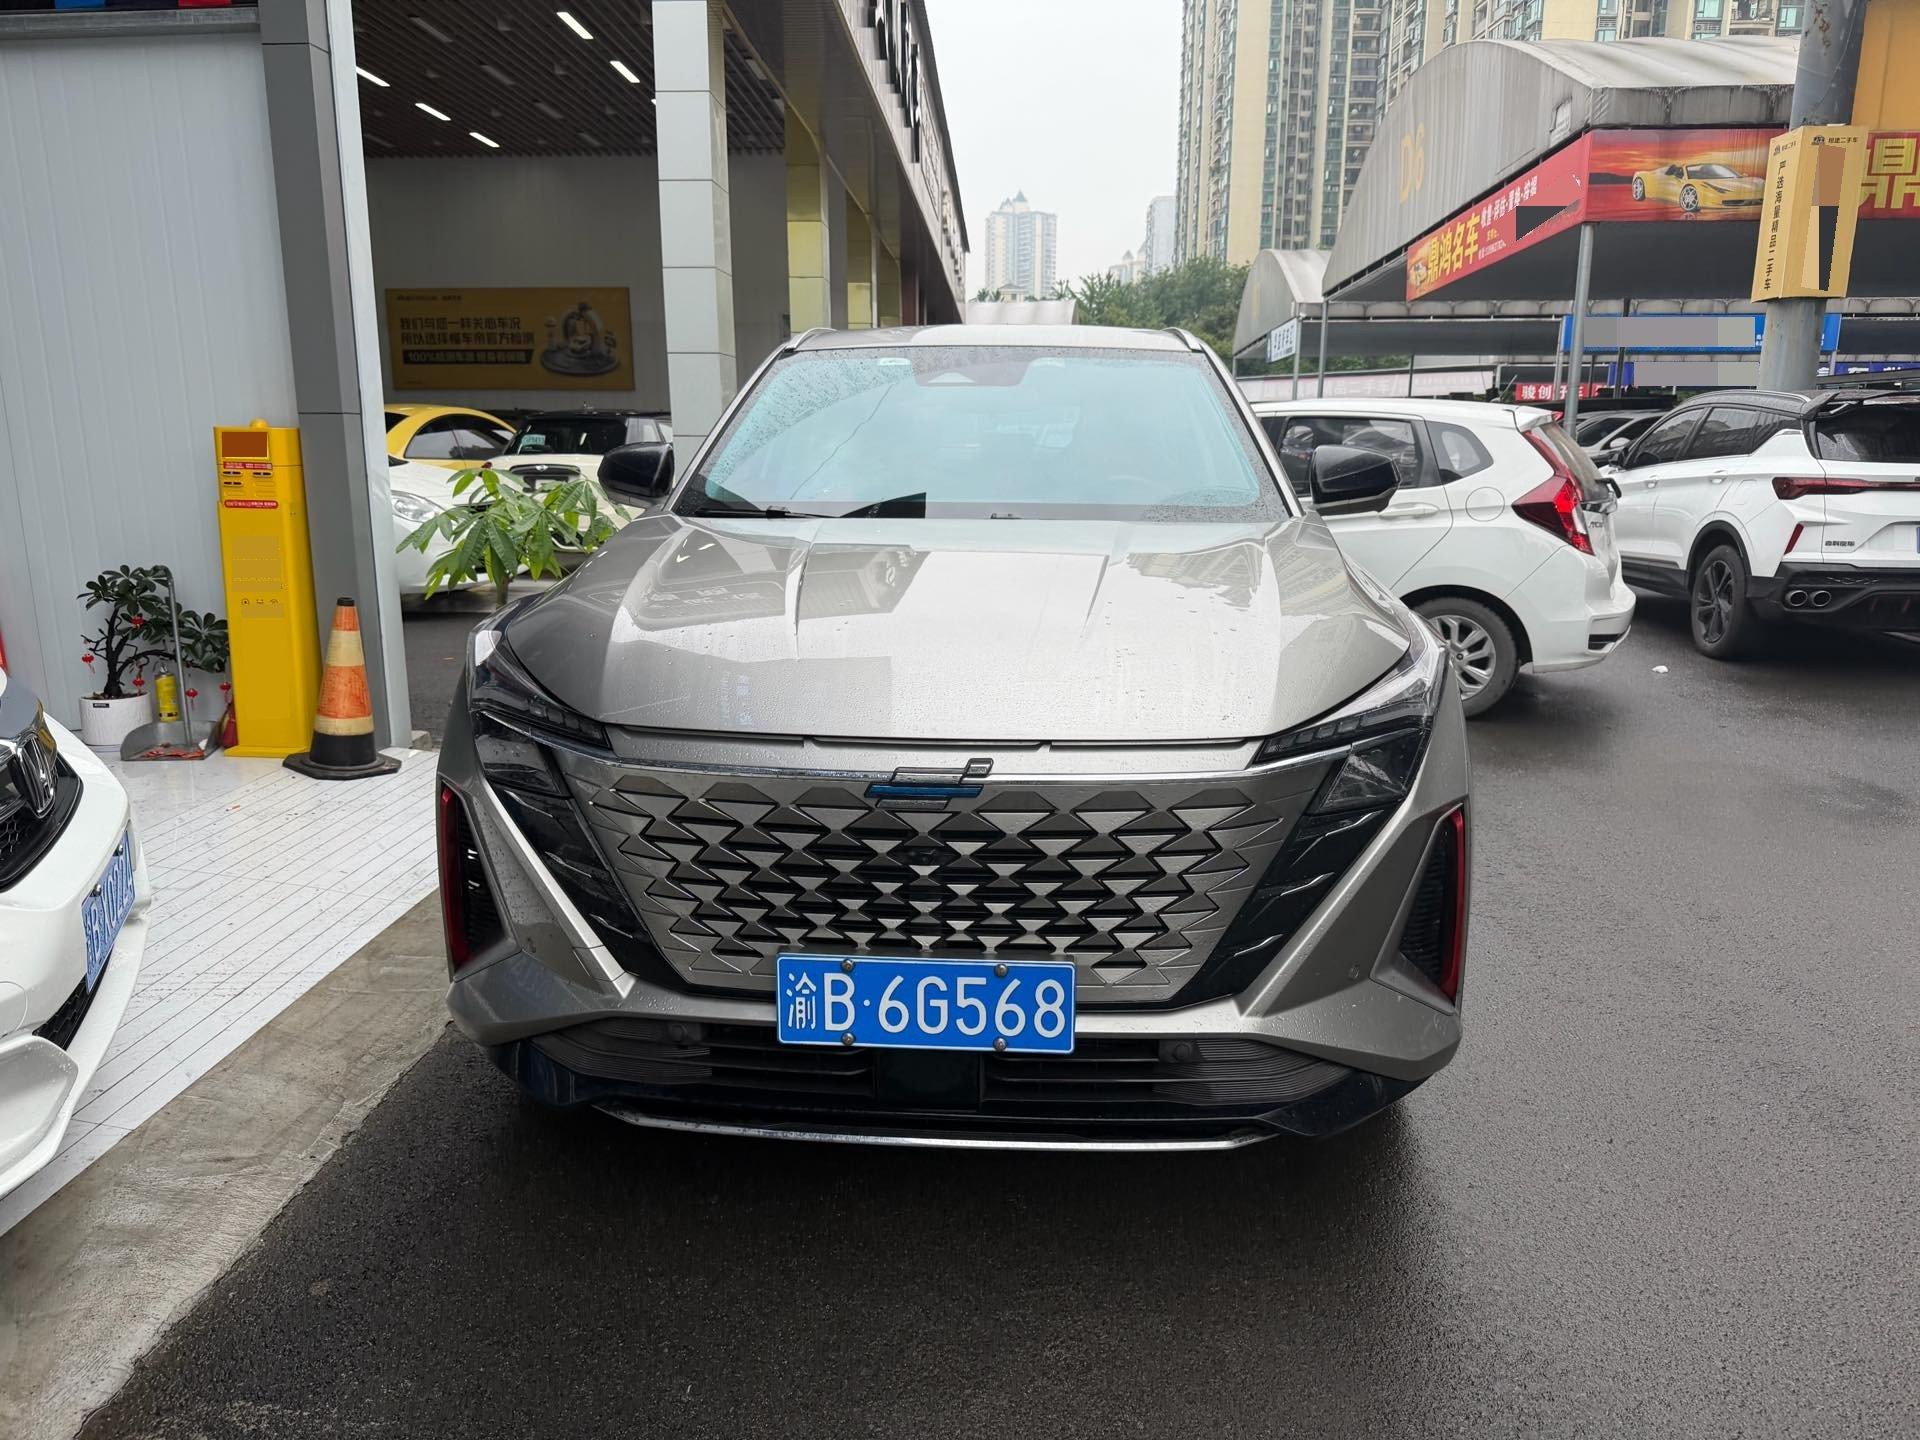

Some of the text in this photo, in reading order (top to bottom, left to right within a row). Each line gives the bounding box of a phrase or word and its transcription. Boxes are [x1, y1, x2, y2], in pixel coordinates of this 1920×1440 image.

[1427, 212, 1480, 284] 鼎鸿名车
[1764, 160, 1787, 291] 严选海量精品二手车
